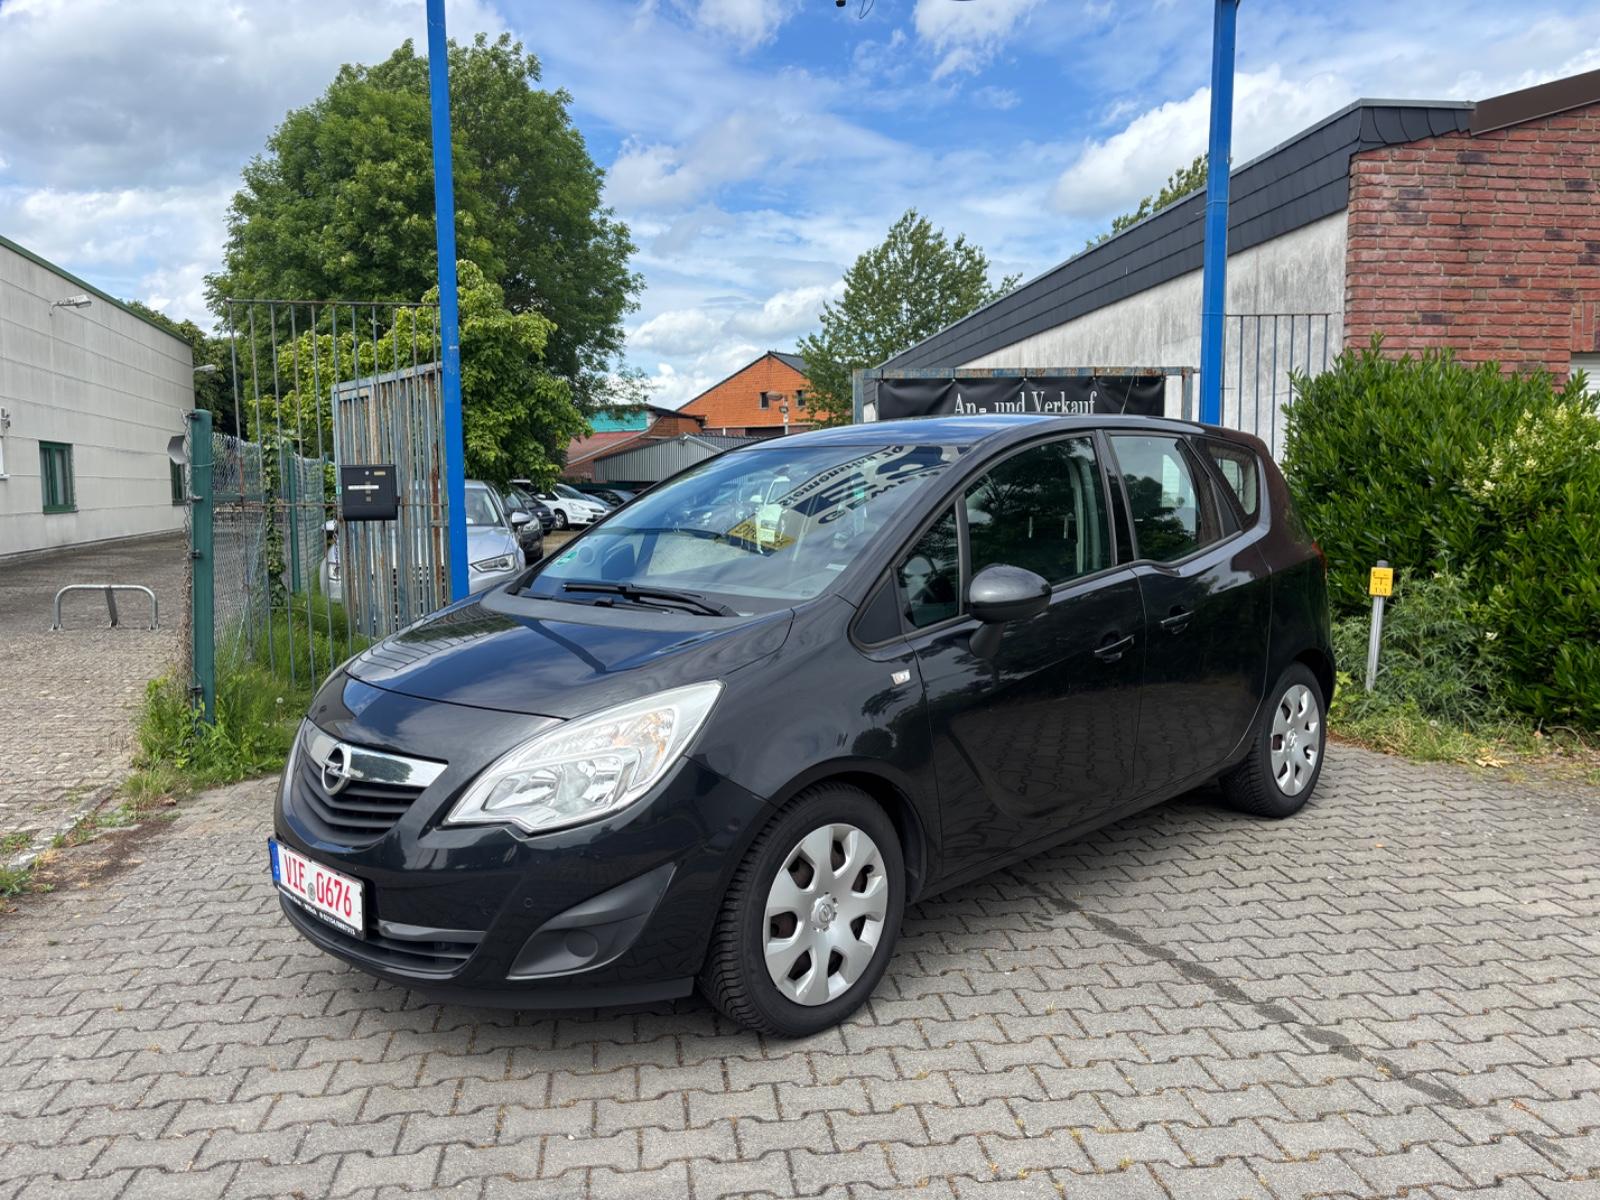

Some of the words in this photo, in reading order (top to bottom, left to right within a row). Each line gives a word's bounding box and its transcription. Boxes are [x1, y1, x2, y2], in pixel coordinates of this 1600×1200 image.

[954, 392, 987, 414] An-
[994, 391, 1025, 413] und
[1032, 391, 1097, 414] Verkauf
[284, 853, 306, 895] VIE
[316, 871, 352, 918] 0676
